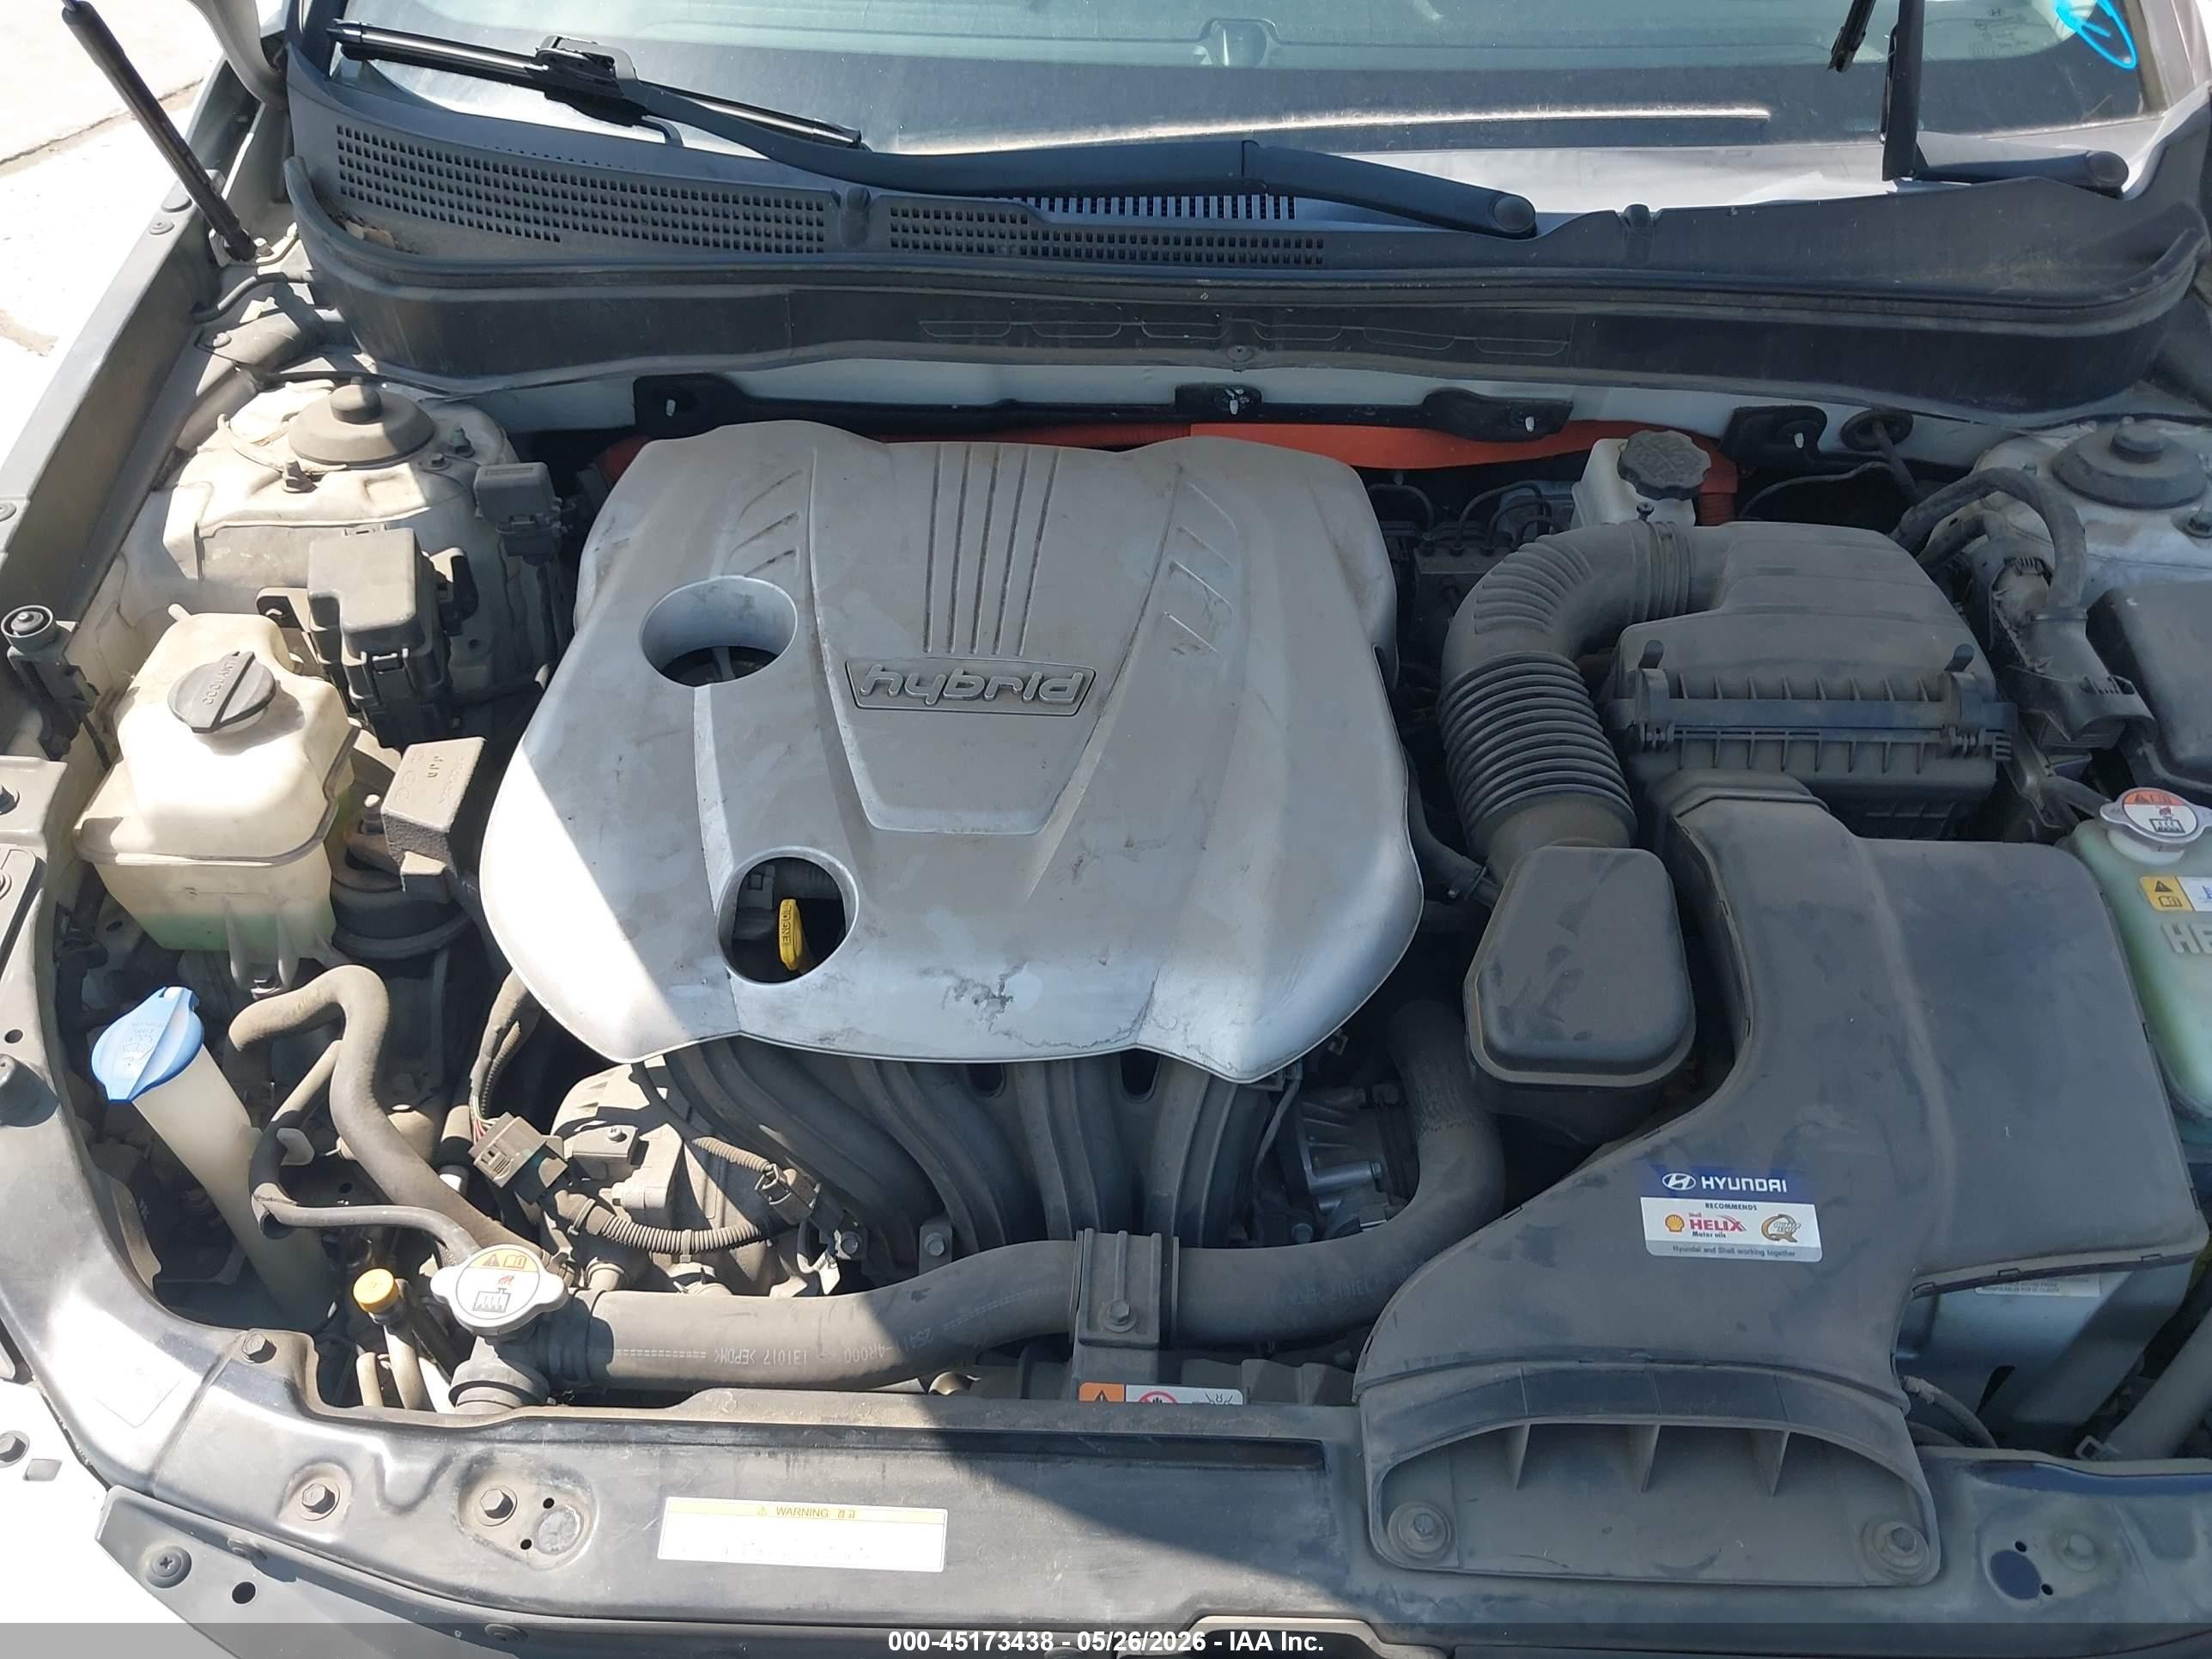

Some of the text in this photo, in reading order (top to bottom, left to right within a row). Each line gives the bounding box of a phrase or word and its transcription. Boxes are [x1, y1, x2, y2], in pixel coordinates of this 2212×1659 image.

[860, 663, 1085, 706] hybrid
[781, 921, 791, 944] ENG
[1701, 1176, 1788, 1193] HYUNDAI
[1705, 1202, 1758, 1211] RECOMMENDS
[1689, 1218, 1746, 1231] HELIX
[1673, 1246, 1701, 1255] Hyundai
[1737, 1249, 1765, 1257] working
[1767, 1249, 1796, 1258] together
[776, 1506, 829, 1518] WARNING
